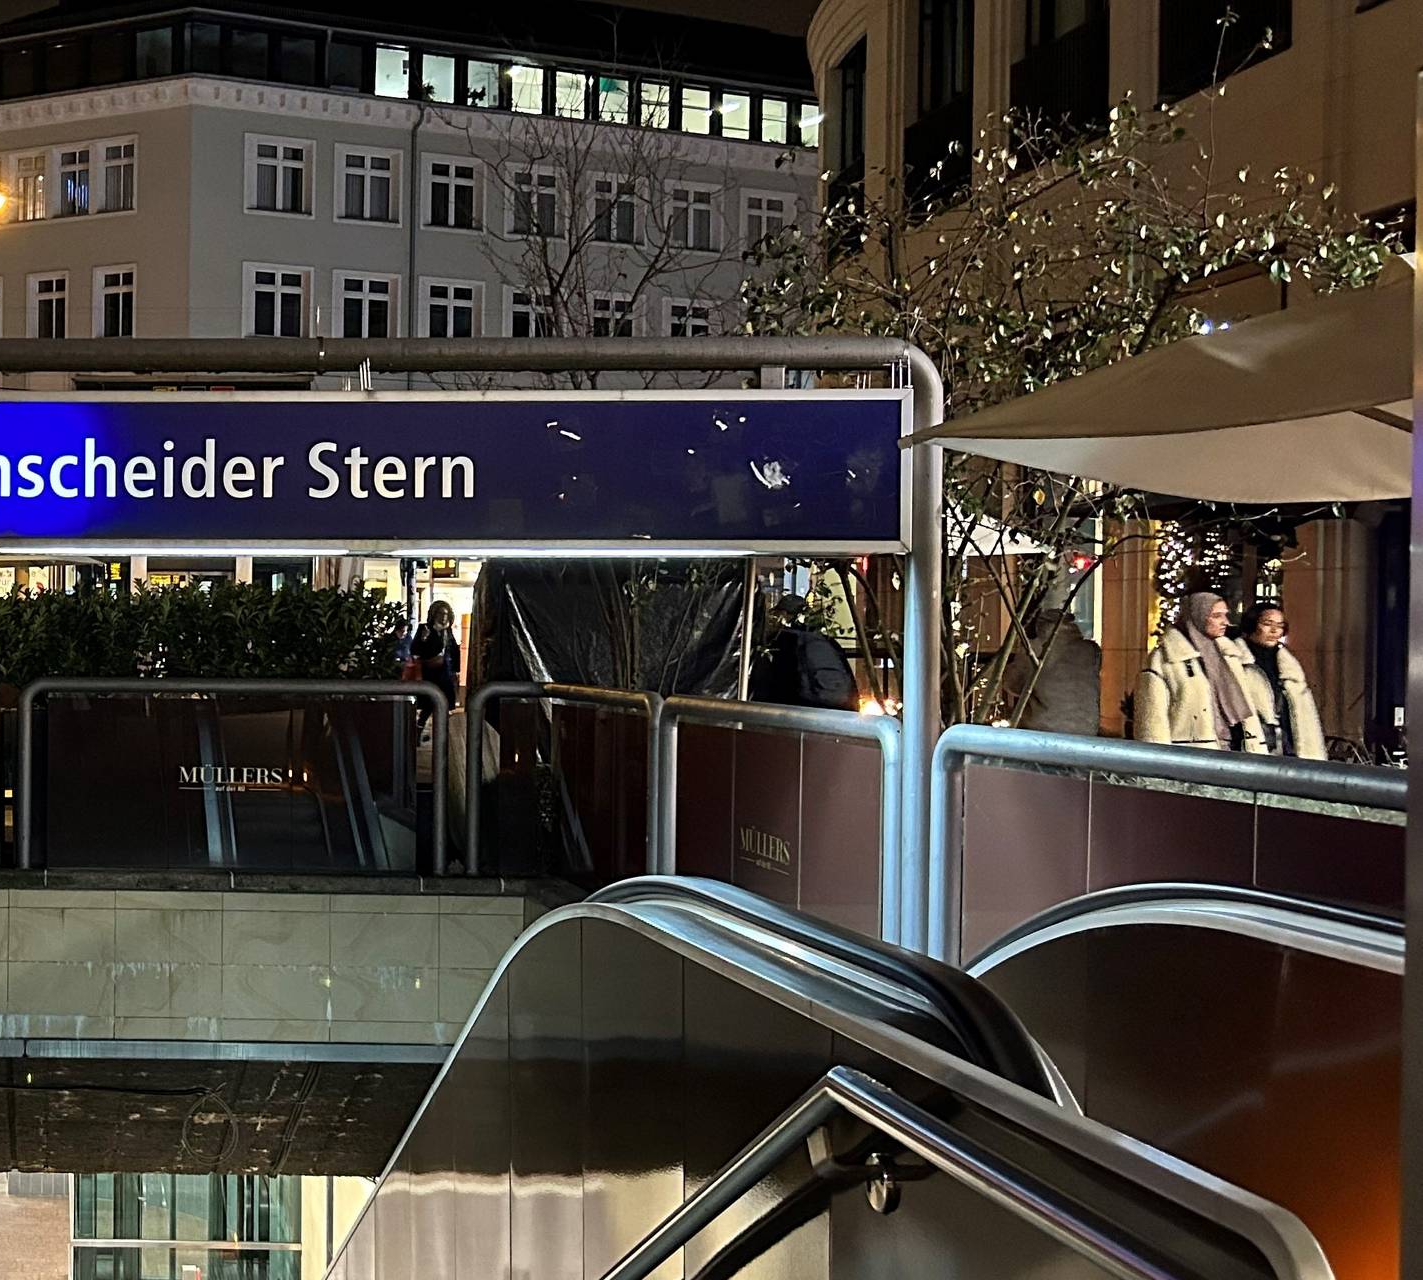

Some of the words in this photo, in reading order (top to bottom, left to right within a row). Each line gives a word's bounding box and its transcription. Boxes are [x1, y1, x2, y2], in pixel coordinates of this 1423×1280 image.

[308, 440, 475, 499] Stern
[178, 763, 282, 785] MÜLLERS
[739, 825, 791, 866] MÜLLERS
